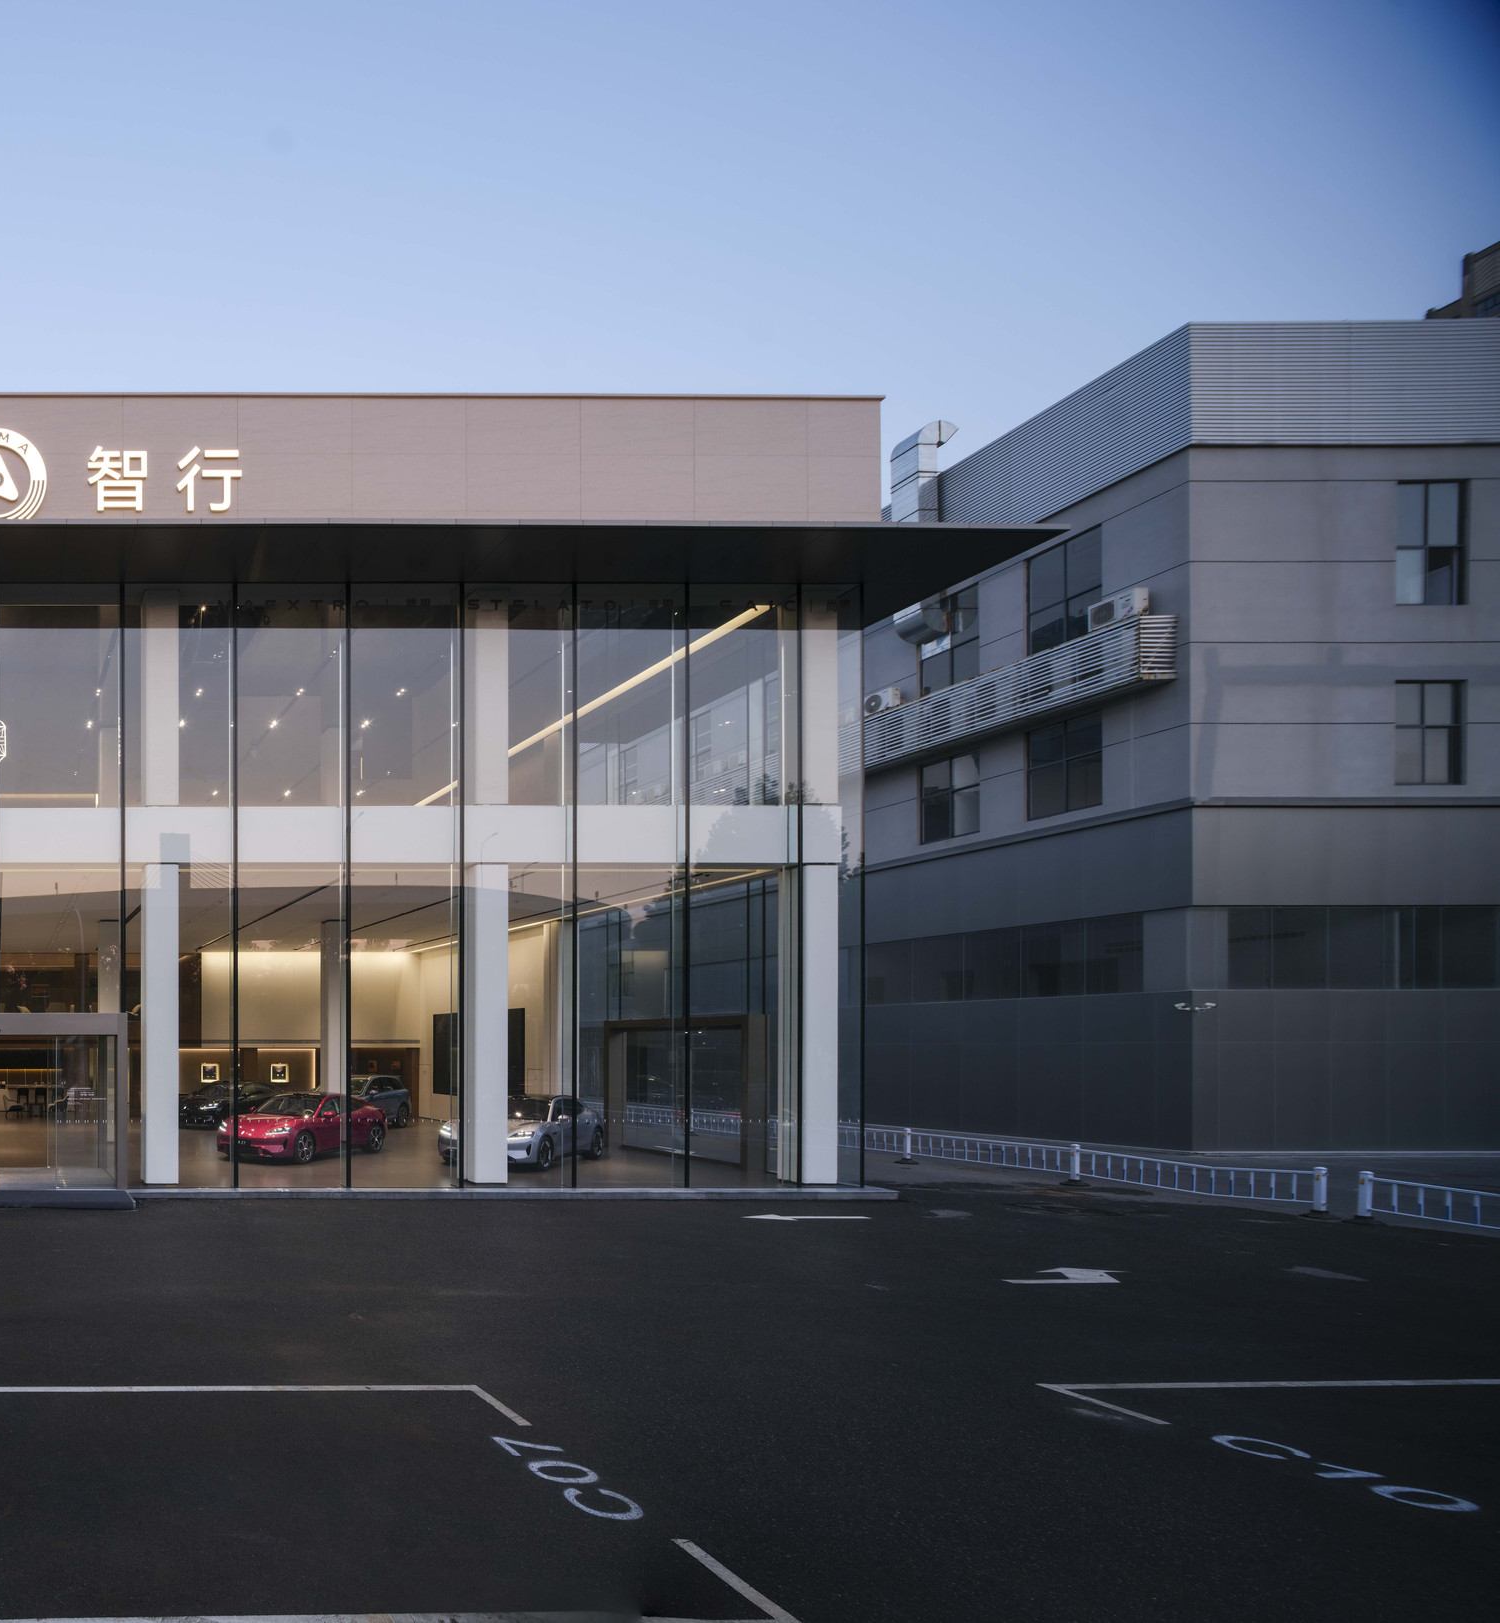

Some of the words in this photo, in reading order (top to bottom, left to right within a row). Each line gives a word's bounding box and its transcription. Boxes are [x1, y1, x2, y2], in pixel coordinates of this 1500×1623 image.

[86, 445, 243, 512] 智行
[217, 599, 369, 611] MAEXTRO
[467, 599, 616, 611] STELATO
[719, 599, 796, 612] SAIC
[491, 1435, 644, 1520] C07
[1211, 1434, 1482, 1512] C10
